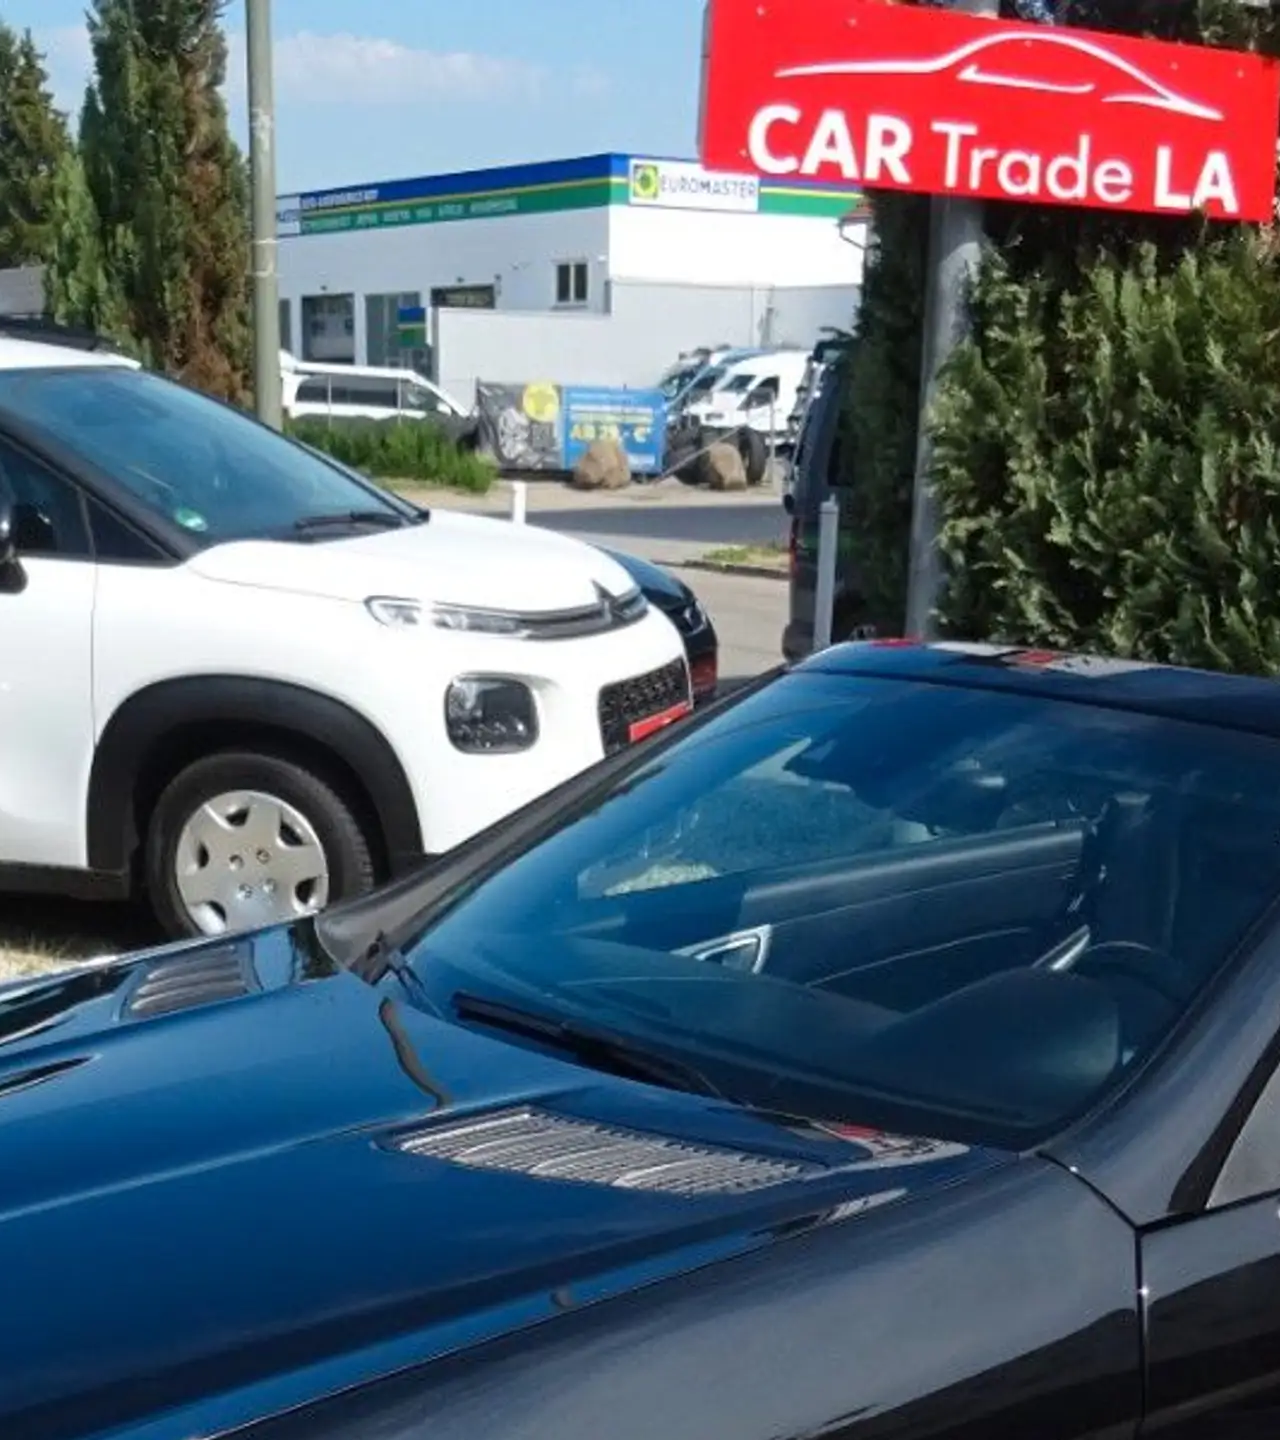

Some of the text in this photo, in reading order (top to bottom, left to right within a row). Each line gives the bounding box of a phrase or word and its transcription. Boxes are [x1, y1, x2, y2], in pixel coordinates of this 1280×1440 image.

[660, 173, 758, 199] EUROMASTER
[747, 103, 1239, 214] CAR Trade LA
